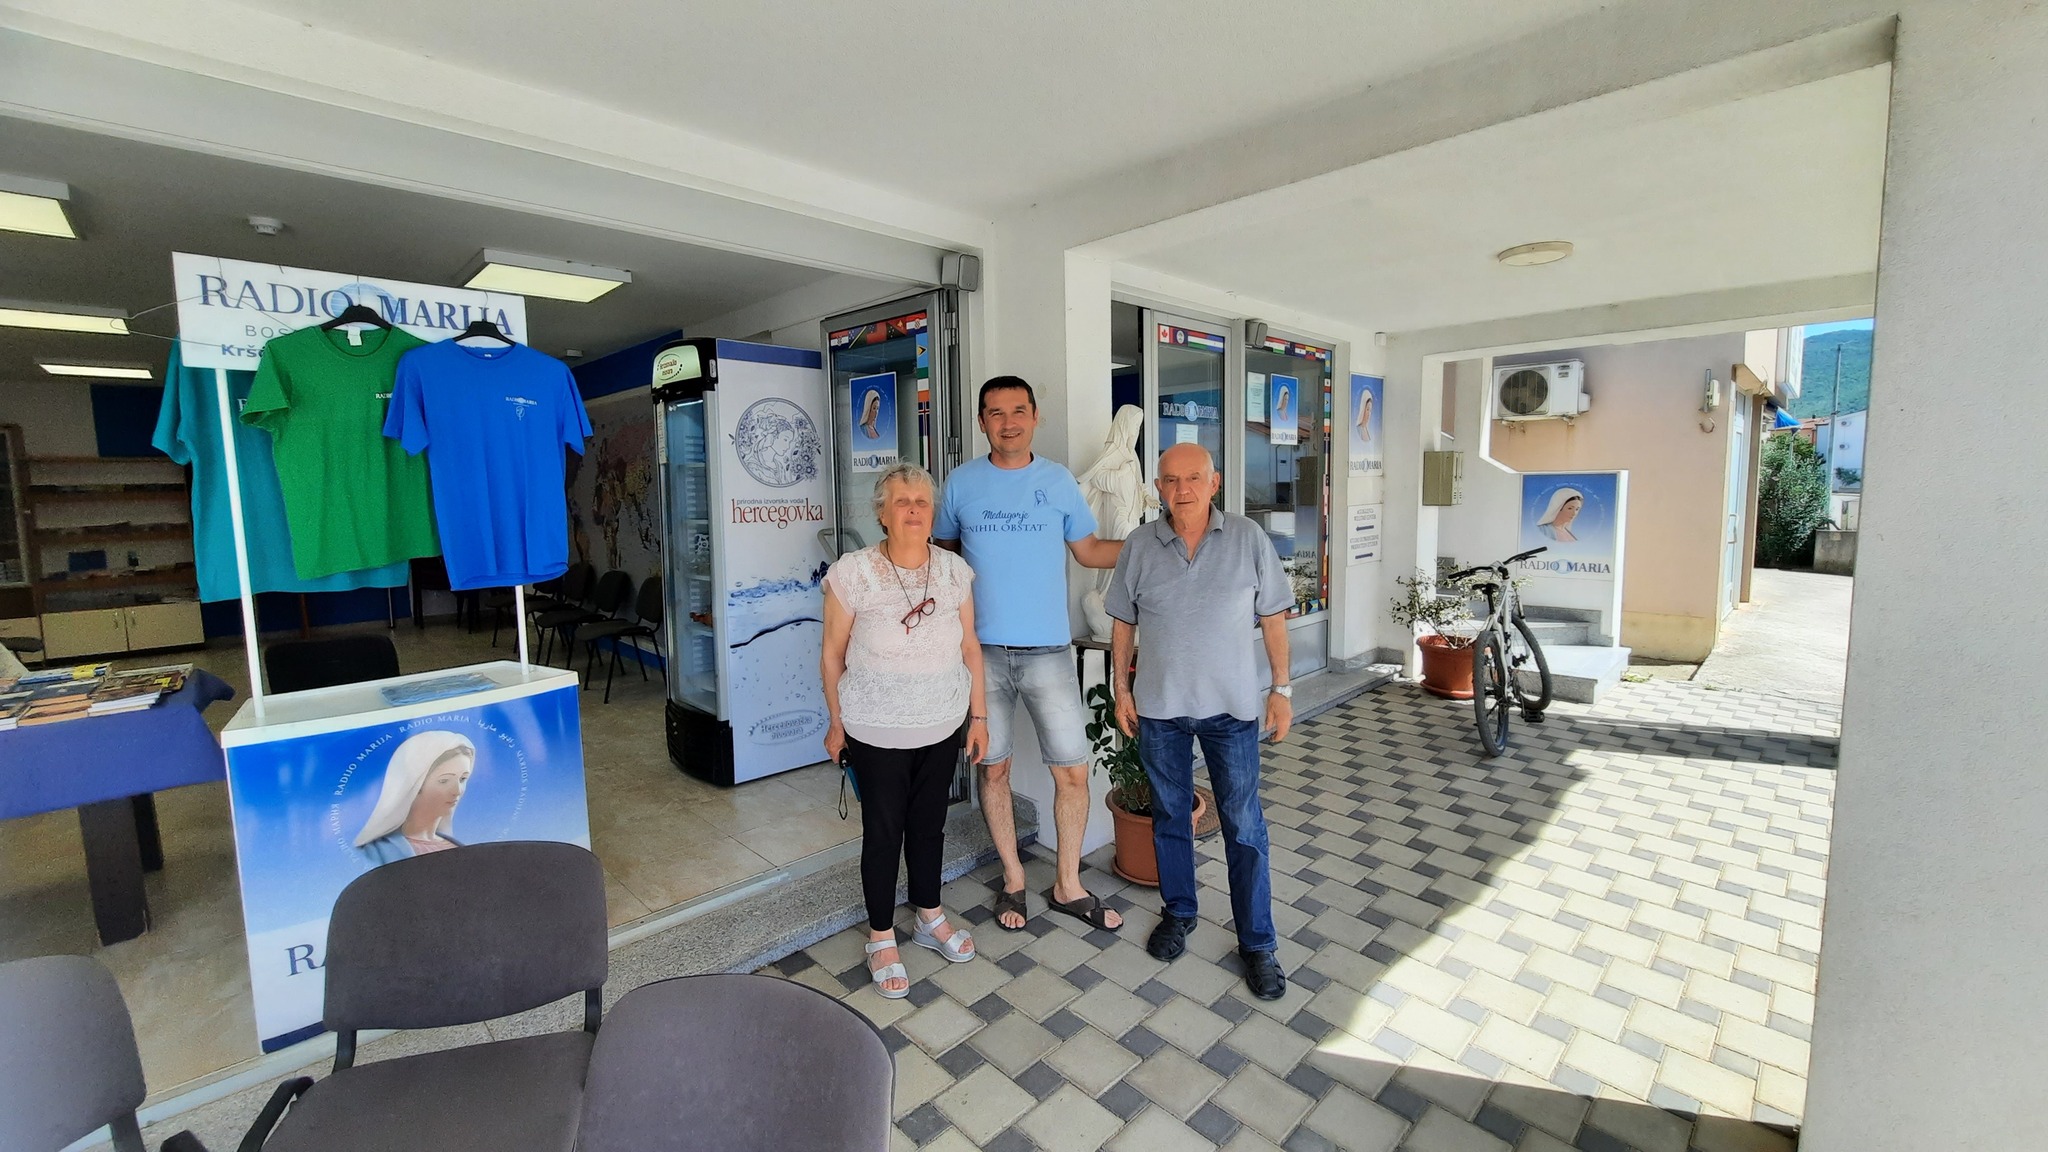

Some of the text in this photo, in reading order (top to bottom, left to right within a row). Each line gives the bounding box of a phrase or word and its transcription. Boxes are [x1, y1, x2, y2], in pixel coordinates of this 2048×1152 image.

[196, 274, 354, 319] RADIO
[245, 325, 292, 338] BOS
[221, 344, 263, 357] Krš
[853, 457, 873, 467] RADIO
[731, 498, 824, 530] hercegovka
[1519, 560, 1611, 574] RADIO MARIA
[399, 715, 471, 733] RADIO MARIA
[334, 733, 393, 796] RADIJO MARIJA
[284, 944, 326, 977] R
